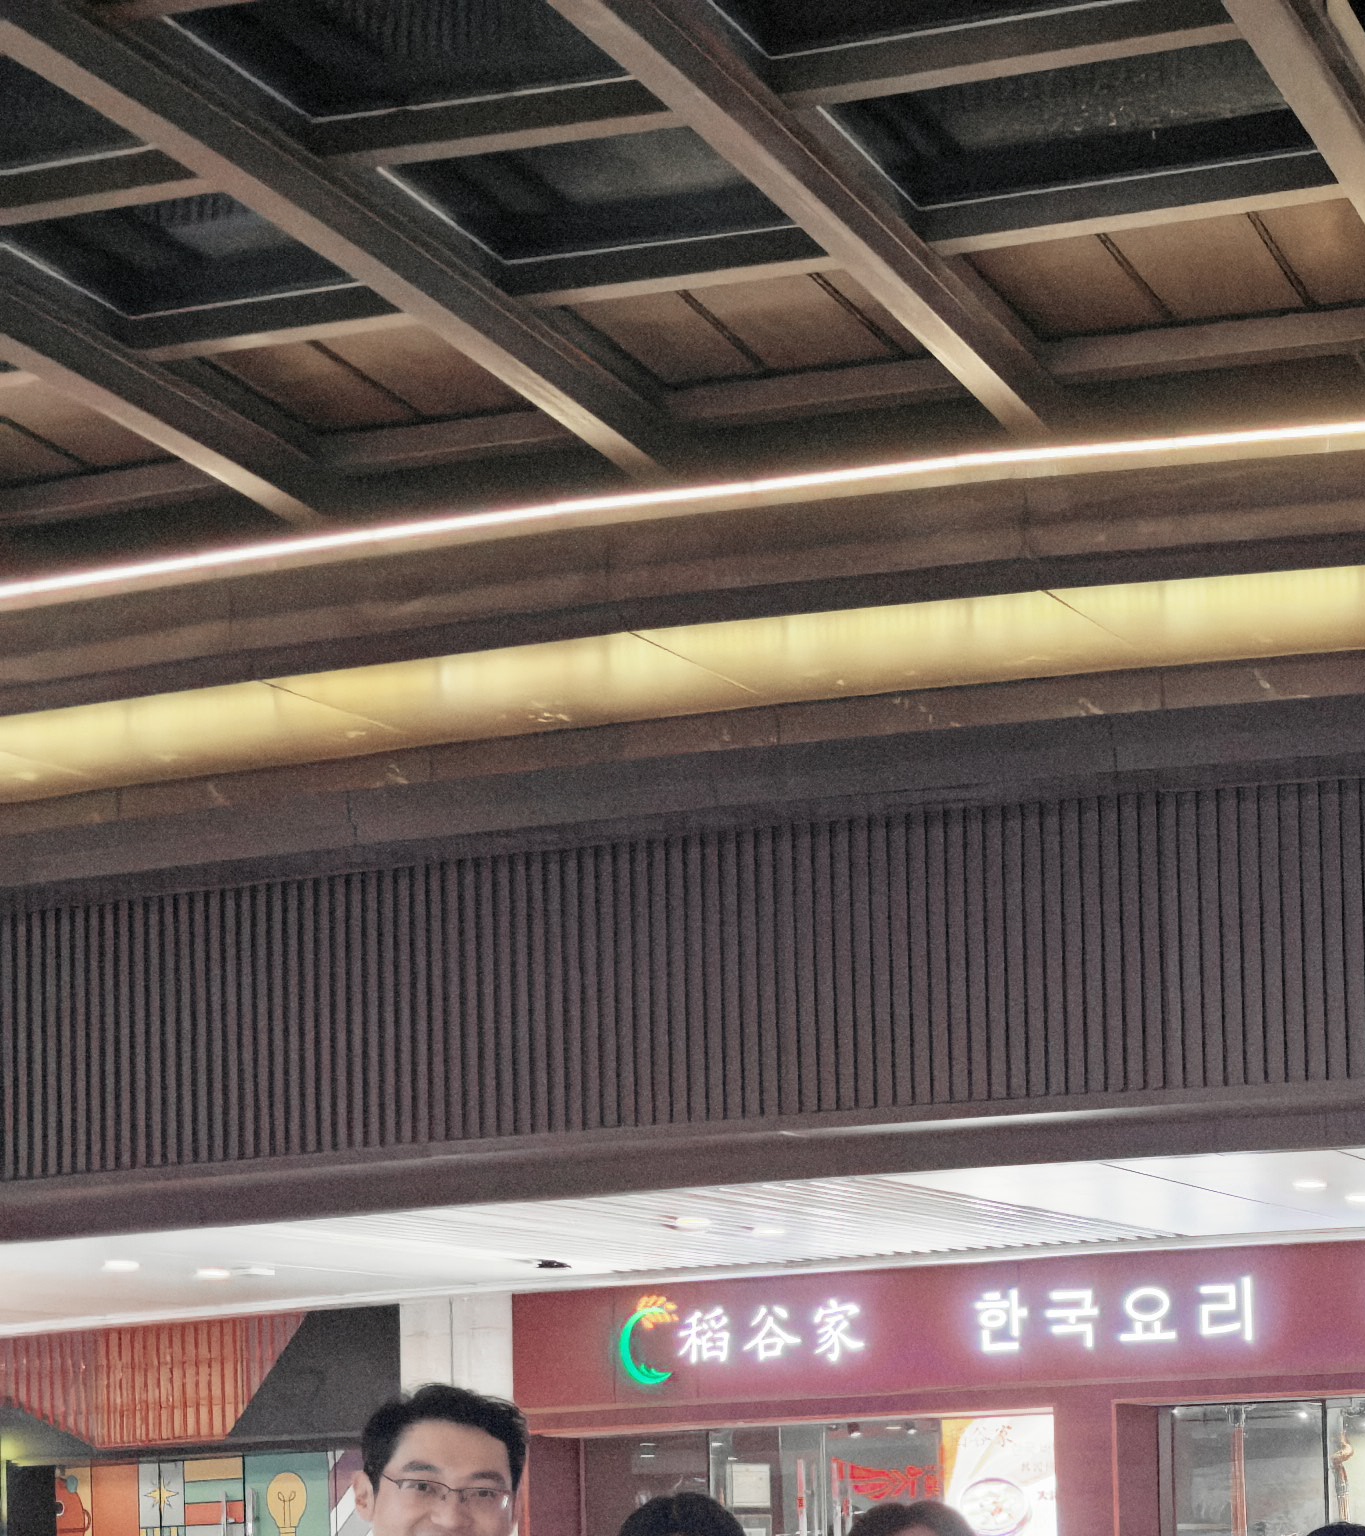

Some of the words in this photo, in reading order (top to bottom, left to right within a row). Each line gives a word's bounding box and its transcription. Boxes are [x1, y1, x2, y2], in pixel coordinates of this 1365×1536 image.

[677, 1297, 866, 1367] 稻谷家
[973, 1275, 1253, 1353] 한국요리
